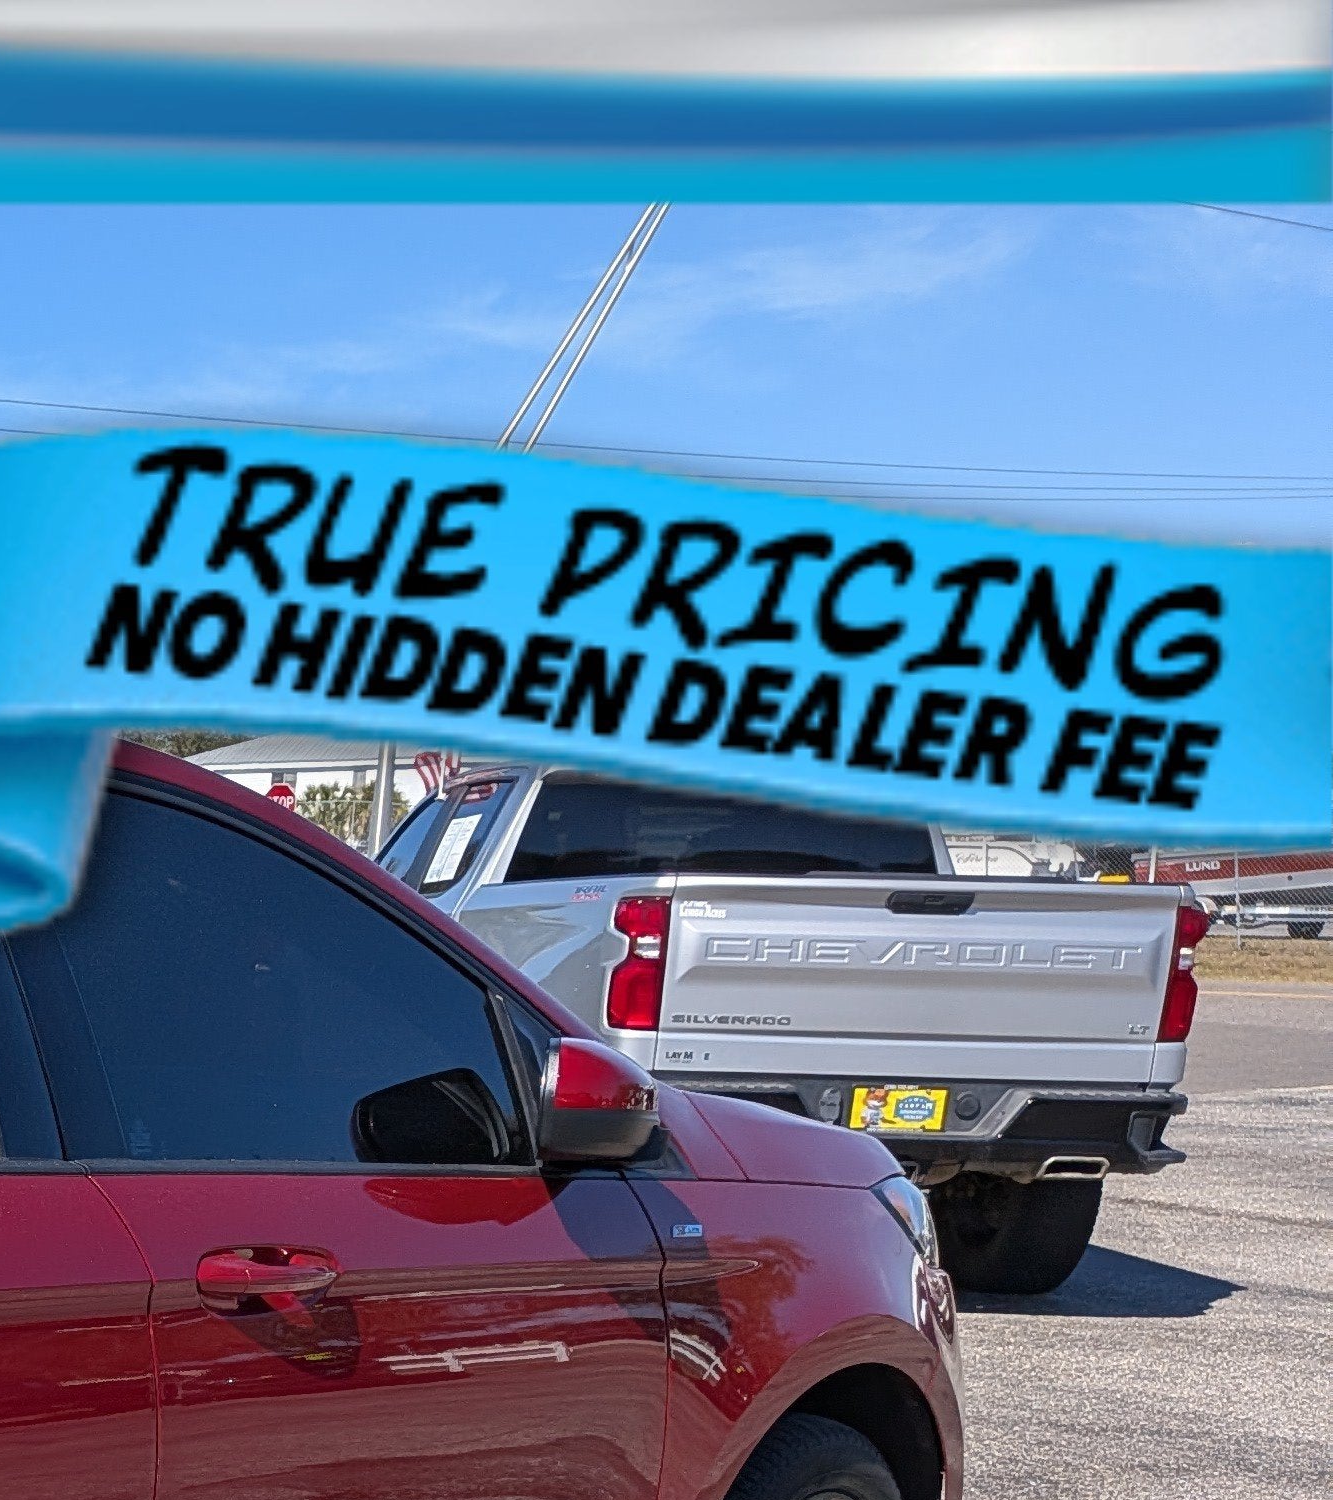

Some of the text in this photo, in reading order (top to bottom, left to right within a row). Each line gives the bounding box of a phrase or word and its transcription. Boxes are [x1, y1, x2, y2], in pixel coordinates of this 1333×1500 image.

[268, 796, 293, 808] TOP
[1185, 860, 1221, 872] LUND
[704, 936, 1142, 971] CHEVROLET
[671, 1014, 791, 1026] SILVERADO
[1128, 1024, 1150, 1035] LT
